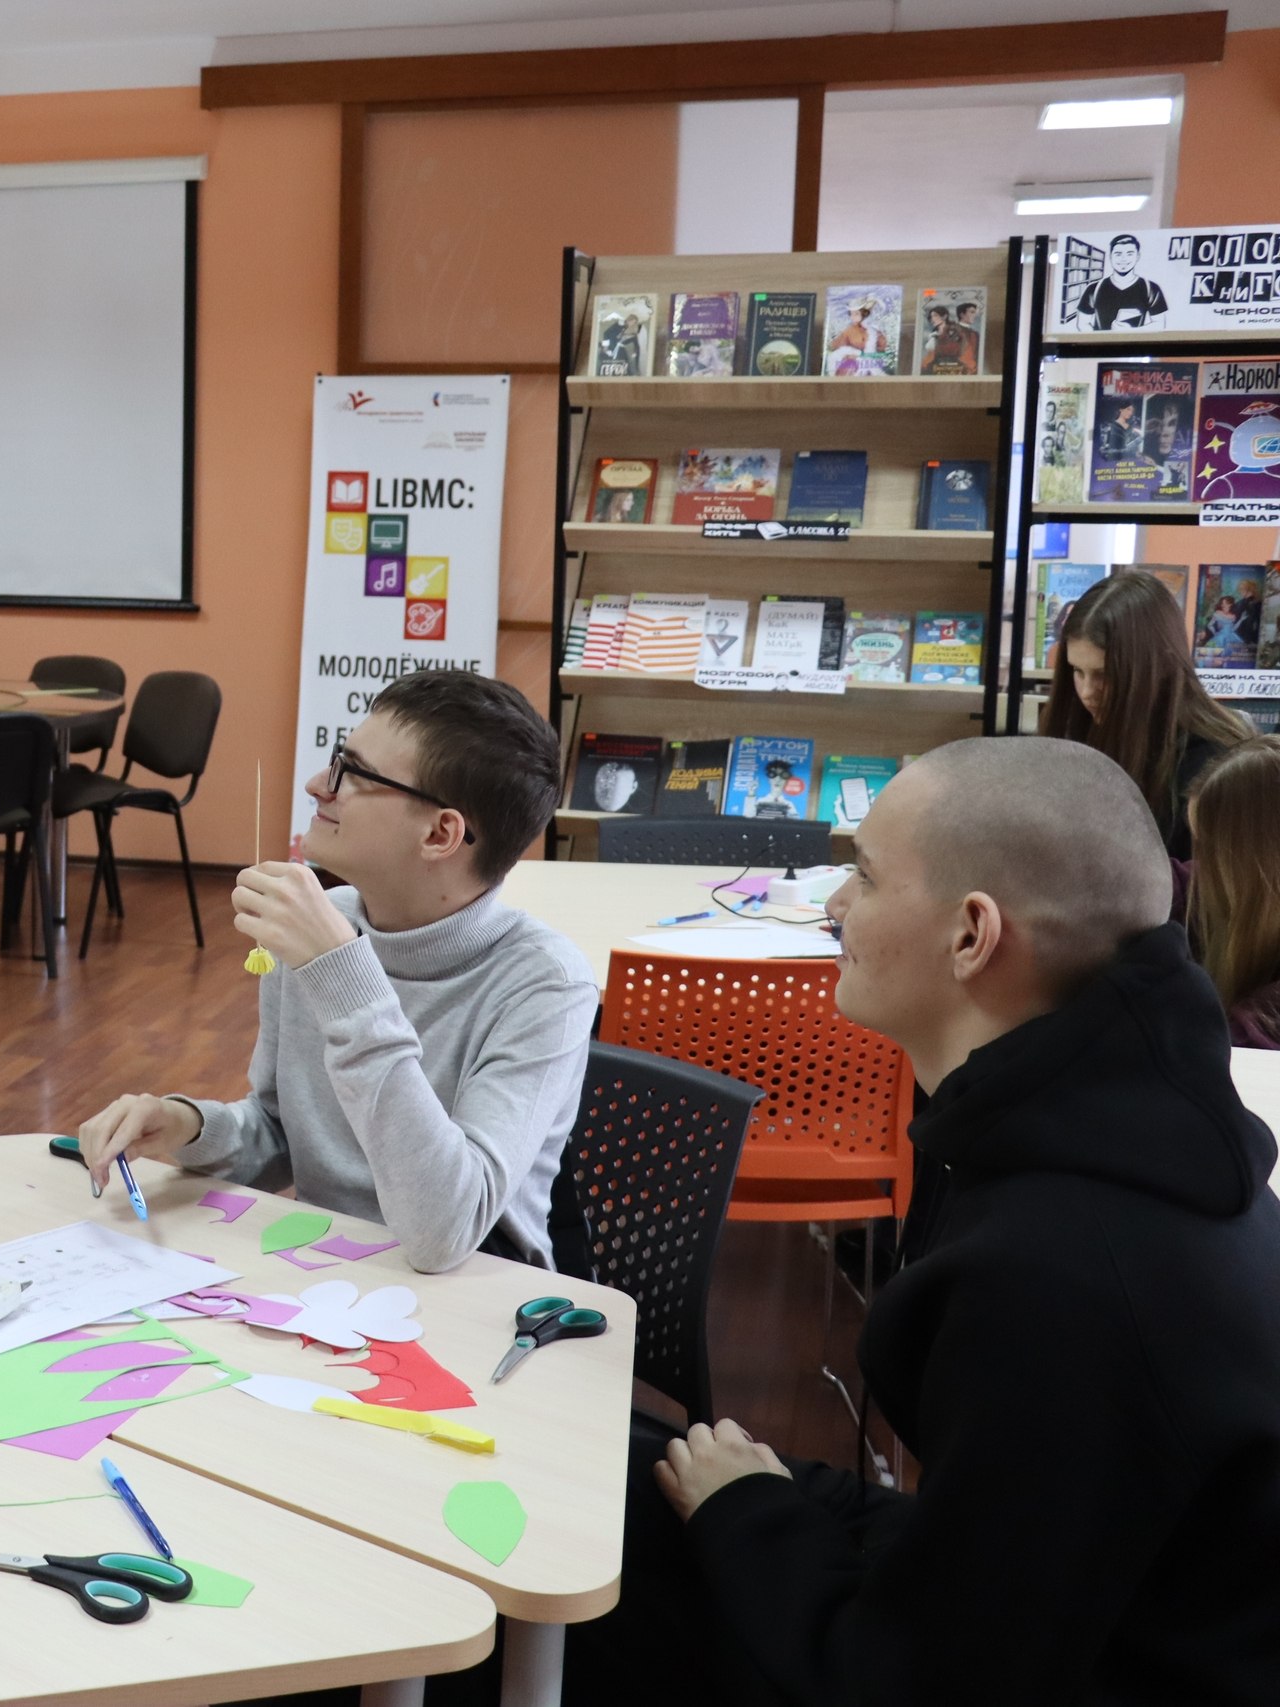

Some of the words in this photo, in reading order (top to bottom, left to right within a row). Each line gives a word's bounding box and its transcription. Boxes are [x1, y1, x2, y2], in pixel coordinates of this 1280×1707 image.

[759, 307, 808, 318] РАДИЩЕВ
[375, 478, 474, 509] LIBMC:
[703, 505, 741, 514] БОРЬБА
[695, 513, 708, 521] ЗА
[711, 513, 748, 521] ОГОНЬ
[1202, 514, 1279, 522] БУЛЬВАР
[788, 526, 835, 536] КЛАССИКА
[633, 599, 706, 607] КОММУНИКАЦИЯ
[698, 669, 775, 678] МОЗГОВОЙ
[698, 679, 748, 687] ШТУРМ
[315, 726, 328, 748] В
[759, 752, 807, 764] ТЕКСТ
